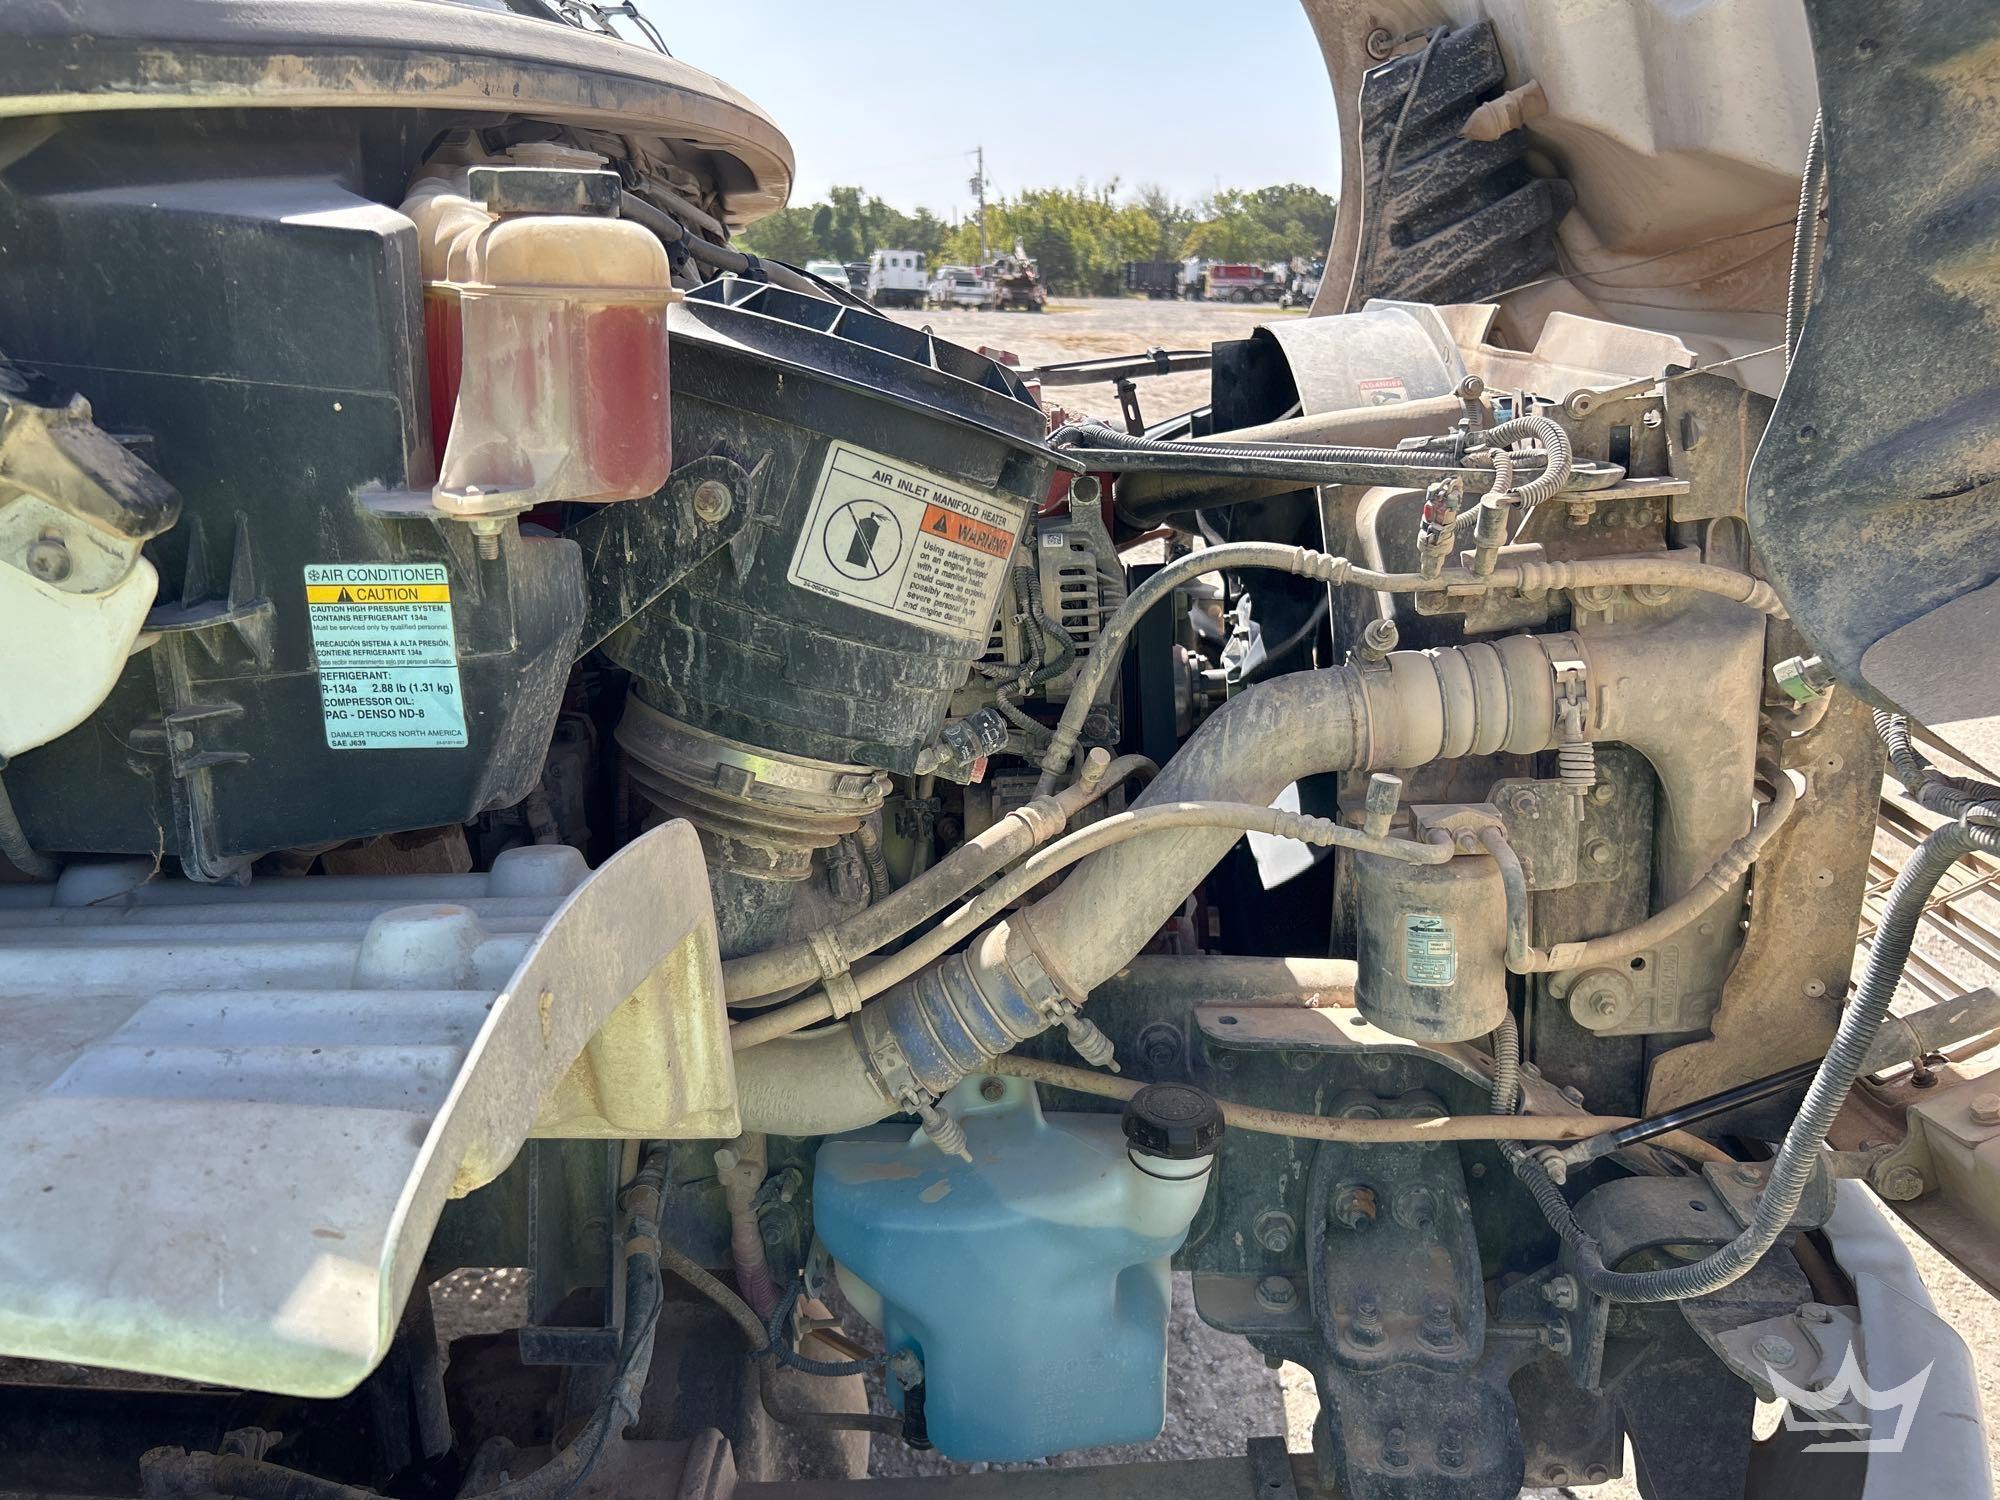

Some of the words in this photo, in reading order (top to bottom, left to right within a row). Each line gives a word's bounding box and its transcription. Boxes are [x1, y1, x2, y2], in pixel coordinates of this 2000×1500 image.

[872, 470, 893, 485] AIR
[897, 478, 930, 498] INLET
[932, 491, 979, 516] MANIFOLD
[981, 509, 1007, 527] HEATER
[958, 523, 1008, 554] WARNING
[923, 540, 945, 557] Using
[948, 550, 972, 566] starting
[919, 552, 930, 561] on
[932, 556, 942, 565] an
[943, 560, 964, 572] engine
[321, 568, 344, 581] AIR
[347, 568, 444, 581] CONDITIONER
[917, 562, 932, 572] with
[941, 569, 968, 583] manifold
[913, 572, 934, 584] could
[935, 579, 955, 590] cause
[356, 587, 419, 601] CAUTION
[909, 581, 941, 598] possibly
[906, 591, 931, 604] severe
[311, 605, 345, 613] CAUTION
[346, 605, 367, 613] HIGH
[412, 605, 446, 613] SYSTEM,
[903, 601, 919, 611] and
[920, 606, 943, 618] engine
[366, 624, 380, 632] only
[381, 624, 389, 632] by
[390, 624, 417, 632] qualified
[315, 639, 361, 648] PRECAUCIÓN
[362, 639, 392, 647] SISTEMA
[400, 639, 417, 647] ALTA
[316, 649, 351, 657] CONTIENE
[321, 671, 392, 680] REFRIGERANT:
[322, 684, 358, 694] R-134a
[372, 684, 394, 693] 2.88
[396, 683, 407, 693] lb
[409, 683, 434, 694] (1.31
[437, 683, 454, 694] kg)
[324, 698, 392, 707] COMPRESSOR
[395, 697, 415, 706] OIL:
[325, 710, 348, 720] PAG
[357, 710, 396, 719] DENSO
[399, 709, 425, 718] ND-8
[331, 731, 366, 739] DAIMLER
[366, 730, 398, 738] TRUCKS
[398, 730, 426, 738] NORTH
[427, 729, 462, 737] AMERICA
[331, 739, 348, 747] SAE
[349, 739, 367, 747] J639
